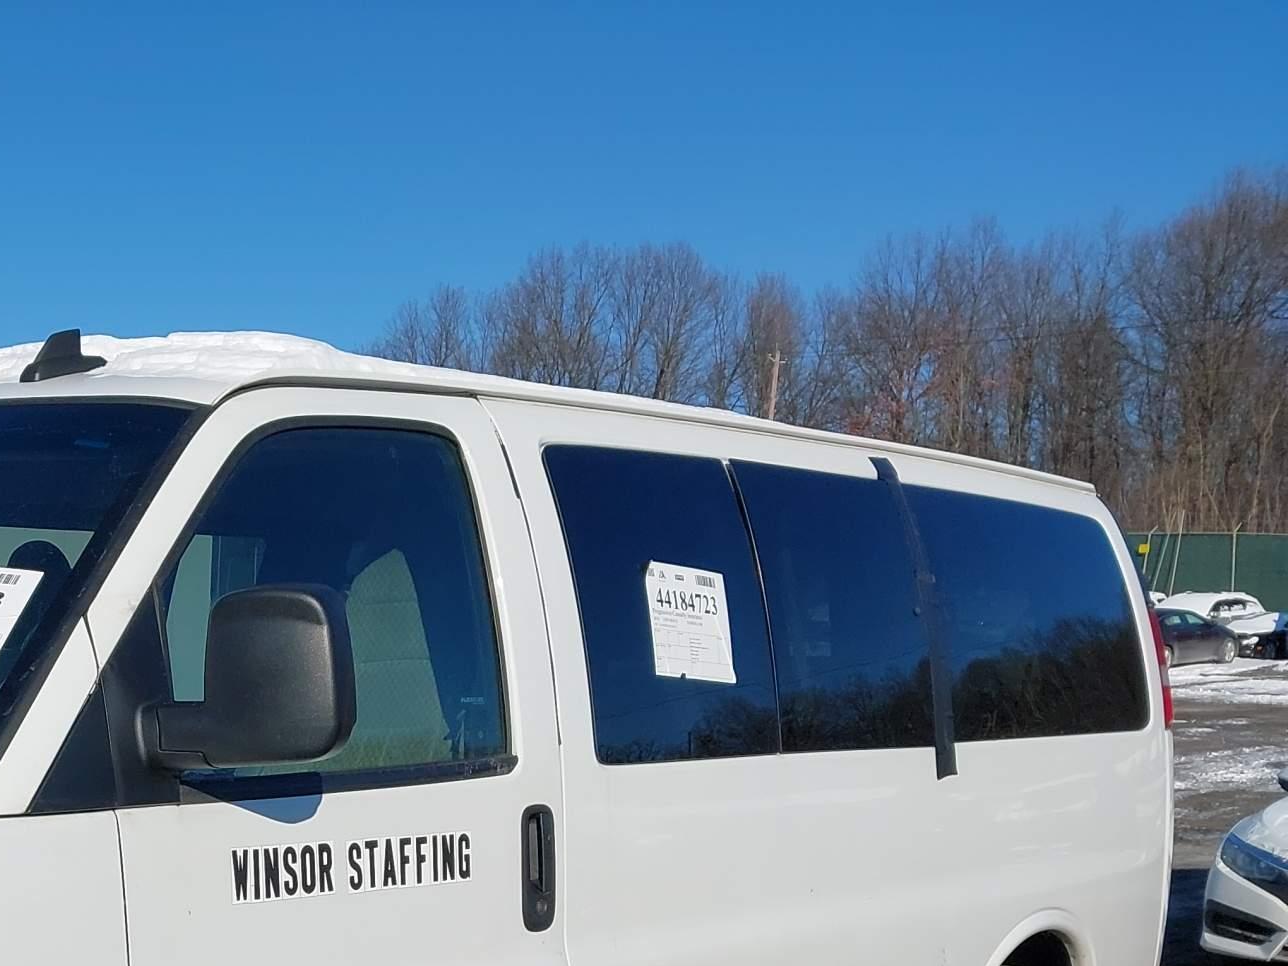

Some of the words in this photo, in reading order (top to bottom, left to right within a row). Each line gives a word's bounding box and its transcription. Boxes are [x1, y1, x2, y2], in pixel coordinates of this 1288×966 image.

[656, 588, 718, 616] 44184723
[231, 842, 334, 902] WINSOR
[347, 832, 472, 891] STAFFING
